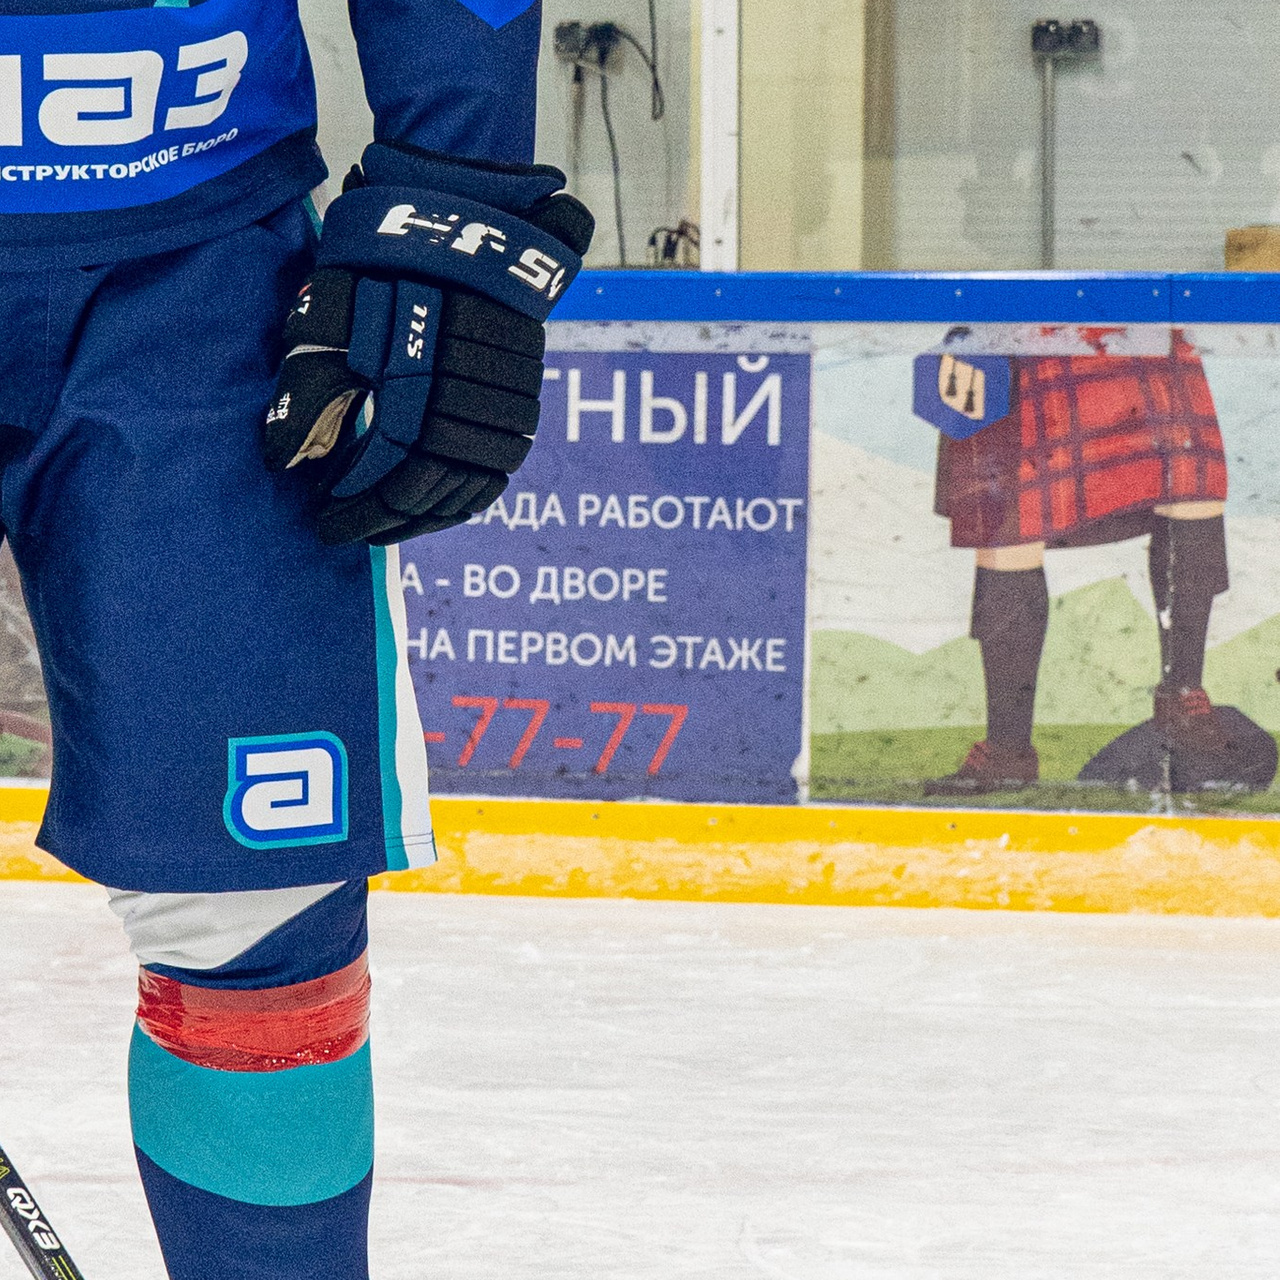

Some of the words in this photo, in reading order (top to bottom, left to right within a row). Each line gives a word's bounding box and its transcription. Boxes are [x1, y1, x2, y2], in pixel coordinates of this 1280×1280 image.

[181, 128, 239, 157] БЮРО
[543, 355, 783, 447] НЫЙ
[578, 493, 804, 533] РАБОТАЮТ
[463, 564, 521, 599] ВО
[529, 567, 669, 605] ДВОРЕ
[466, 628, 638, 668] ПЕРВОМ
[648, 635, 788, 672] ЭТАЖЕ
[6, 1186, 61, 1251] QX3
